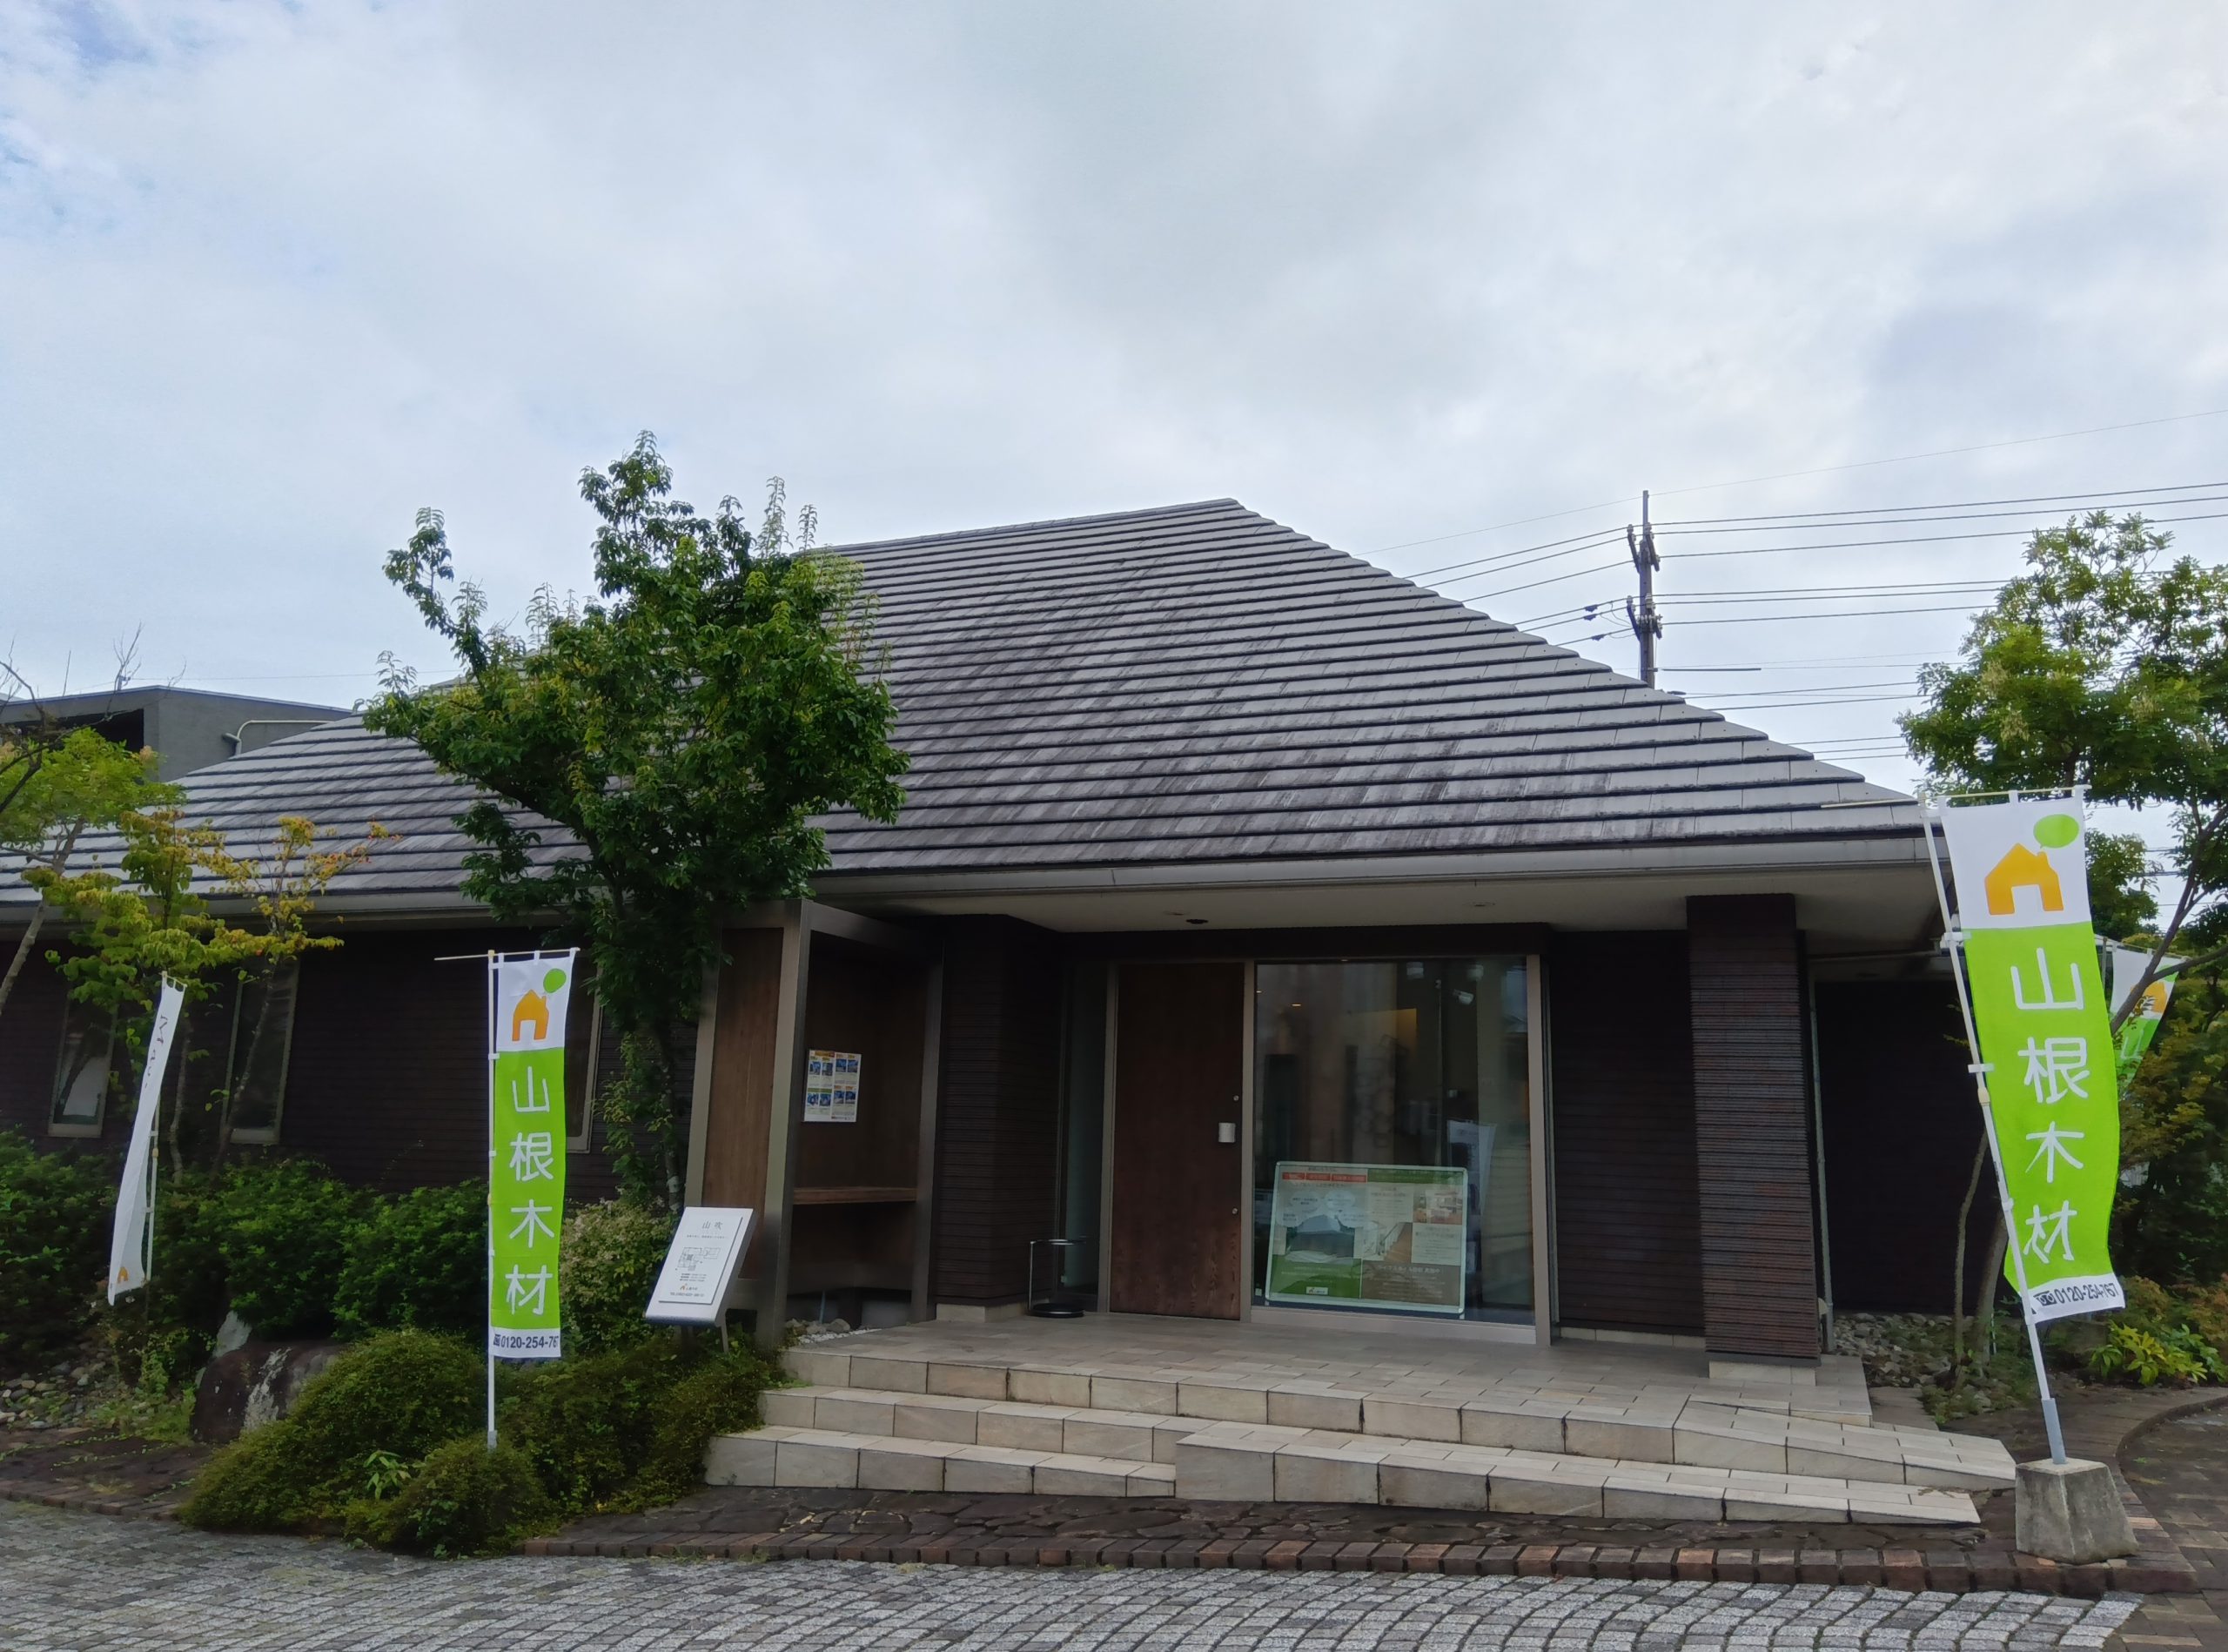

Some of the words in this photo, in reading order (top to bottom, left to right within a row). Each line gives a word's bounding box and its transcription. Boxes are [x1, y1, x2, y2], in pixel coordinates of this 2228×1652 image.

[505, 1065, 555, 1316] 山根木材
[2010, 947, 2089, 1264] 山根木材
[500, 1335, 560, 1349] 0120-254-76
